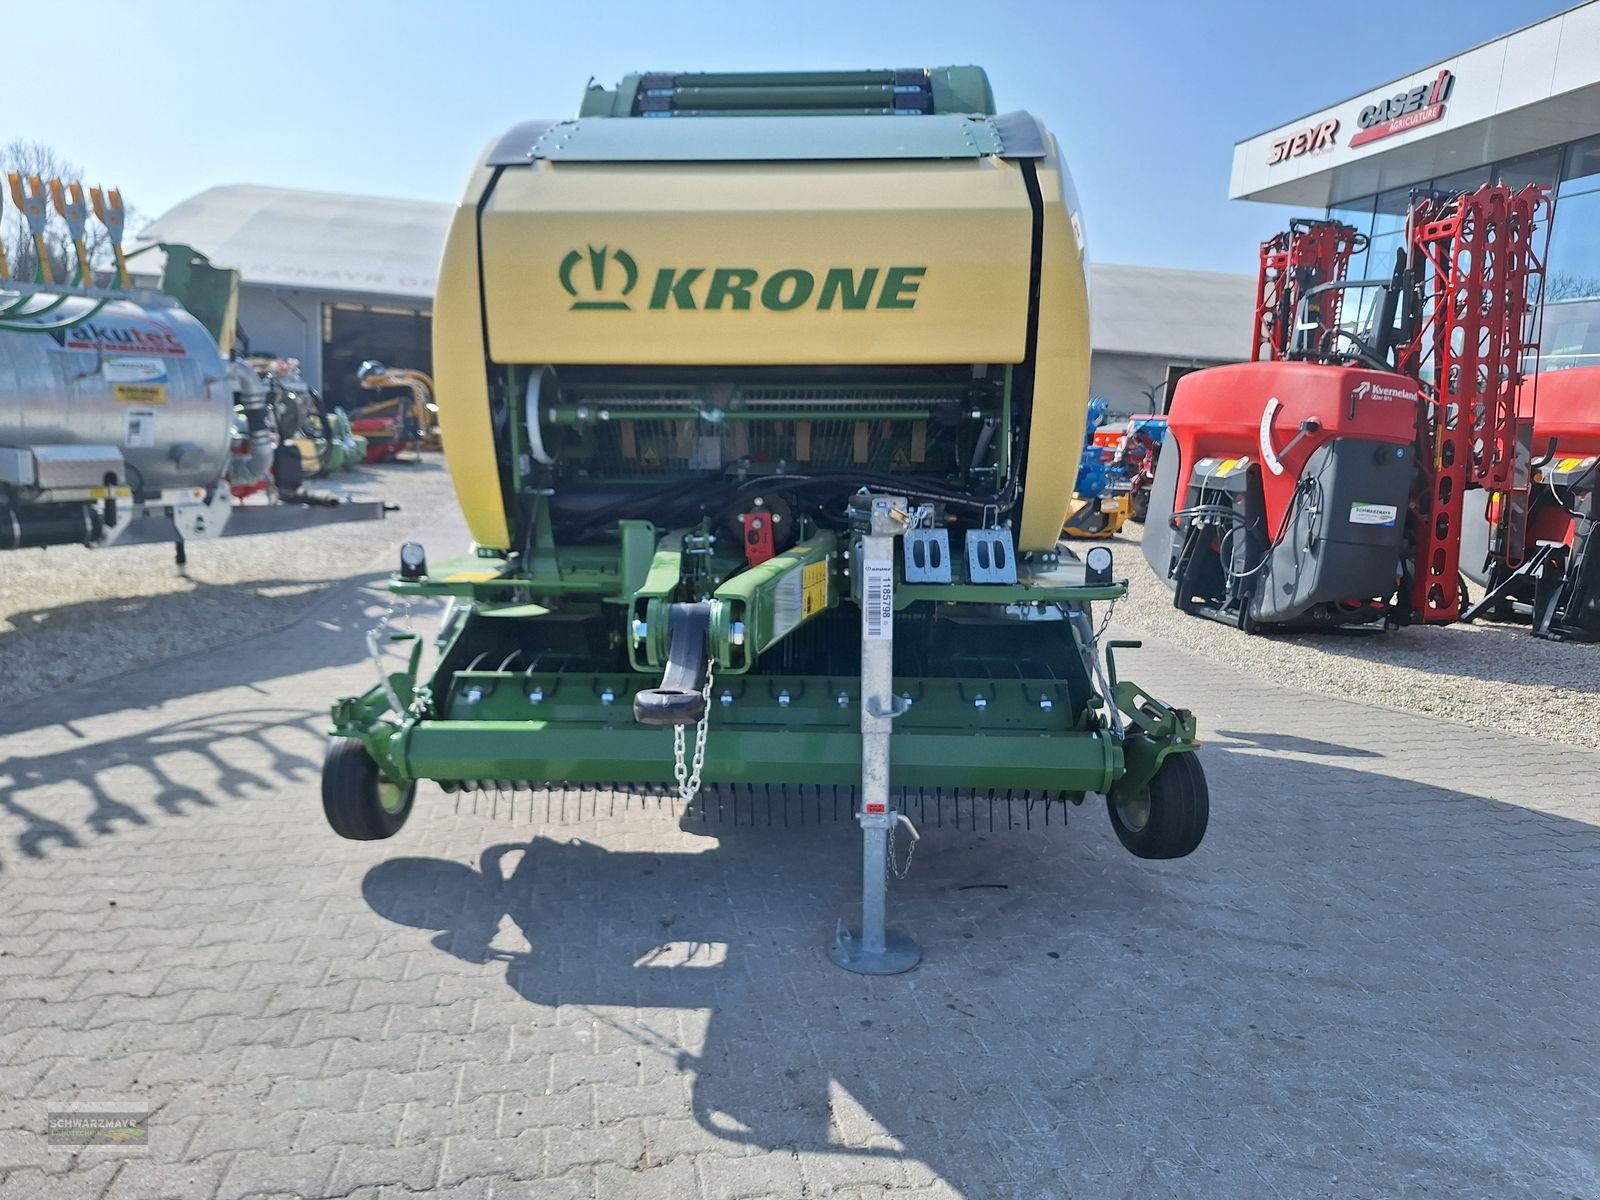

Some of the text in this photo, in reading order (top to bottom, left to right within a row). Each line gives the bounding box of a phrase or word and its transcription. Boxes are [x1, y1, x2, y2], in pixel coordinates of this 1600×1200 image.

[1389, 107, 1438, 132] AGRICULTURE
[1266, 118, 1340, 166] STEYR
[648, 266, 928, 312] KRONE
[1372, 384, 1418, 401] Kverneland
[882, 577, 891, 618] 1185798
